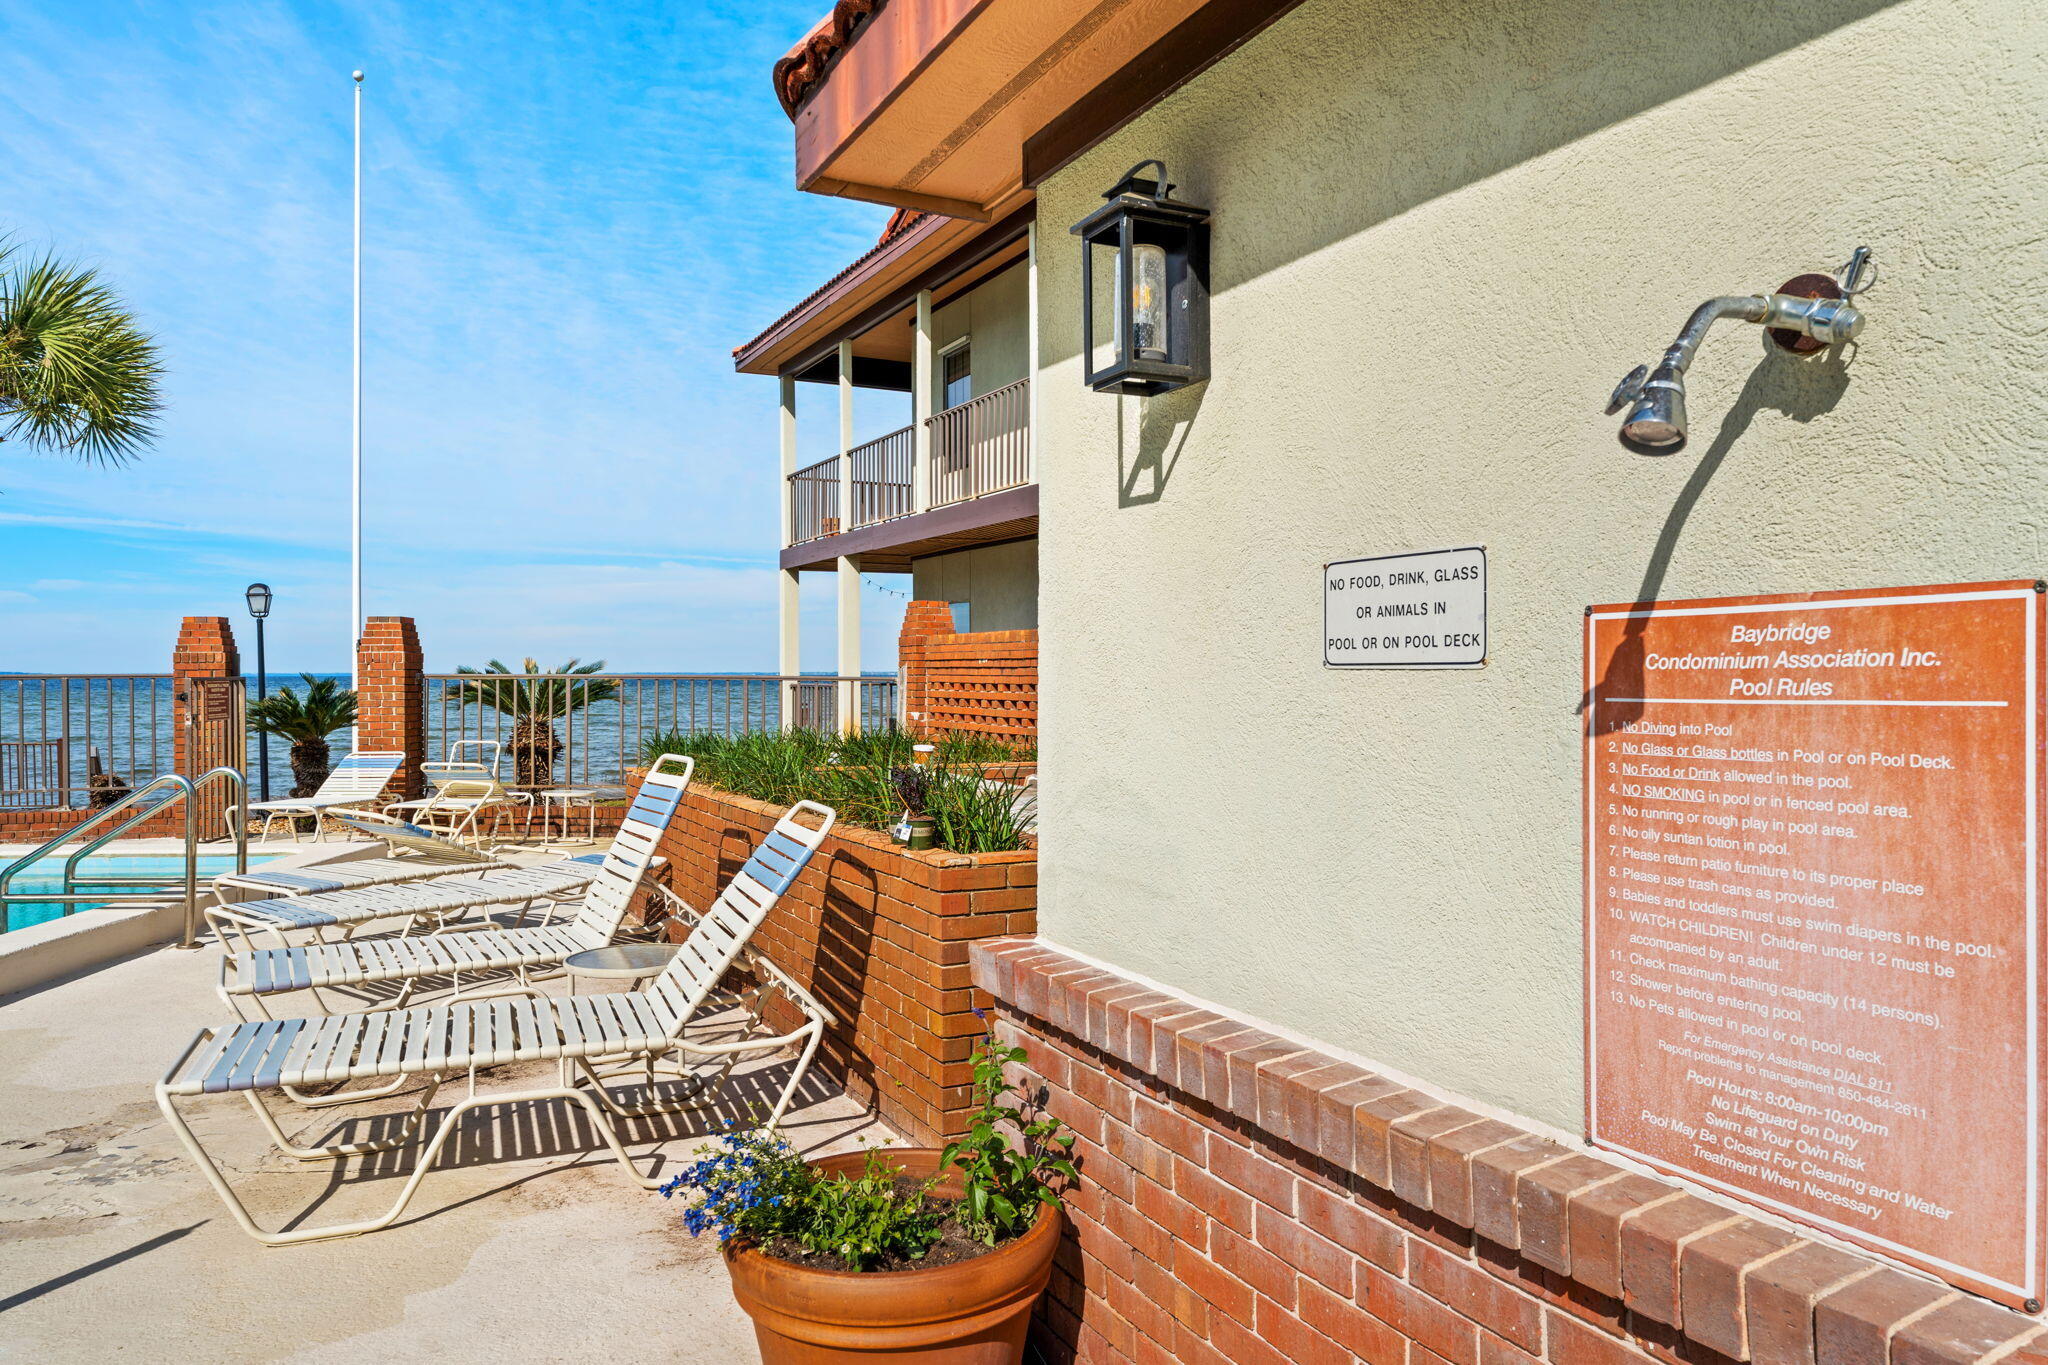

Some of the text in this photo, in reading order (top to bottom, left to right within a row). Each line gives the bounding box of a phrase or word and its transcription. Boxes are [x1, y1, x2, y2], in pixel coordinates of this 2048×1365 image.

[1330, 566, 1478, 591] NO FOOD, DRINK, GLASS
[1356, 602, 1446, 618] OR ANIMALS IN
[1328, 634, 1480, 650] POOL OR ON POOL DECK
[1730, 623, 1831, 645] Baybridge
[1645, 647, 1941, 670] Condominium Association Inc.
[1729, 678, 1834, 696] Pool Rules
[1622, 721, 1732, 736] No Diving into Pool
[1622, 742, 1955, 769] No Glass or Glass bottles in Pool or on Pool Deck.
[1622, 763, 1852, 789] No Food or Drink allowed in the pool.
[1622, 784, 1912, 818] NO SMOKING in pool or in fenced pool area.
[1622, 805, 1858, 838] No running or rough play in pool area.
[1622, 826, 1790, 856] No suntan lotion in pool.
[1622, 846, 1924, 896] Please return patio furniture to its proper place
[1622, 867, 1839, 909] Please use trash cans as provided.
[1622, 888, 1996, 959] Babies and toddlers must use swim diapers in the pool.
[1630, 911, 1955, 979] WATCH CHILDREN! Children under 12 must be
[1630, 933, 1783, 971] accompanied by an adult.
[1630, 952, 1944, 1030] Check maximum bathing capacity (14 persons).
[1630, 973, 1805, 1024] Shower before entering pool.
[1630, 995, 1886, 1066] No Pets allowed in pool or on pool deck.
[1658, 1039, 1927, 1120] Report problems to management 850-484-2611
[1684, 1031, 1893, 1094] For Emergency Assistance DIAL 911
[1687, 1069, 1889, 1137] Pool Hours: 8:00am-10:00pm
[1712, 1095, 1859, 1151] No Lifeguard on Duty
[1705, 1112, 1867, 1172] Swim at Your Own Risk
[1641, 1110, 1954, 1220] Pool May Be Closed For Cleaning and Water
[1693, 1144, 1883, 1220] Treatment When Necessary
